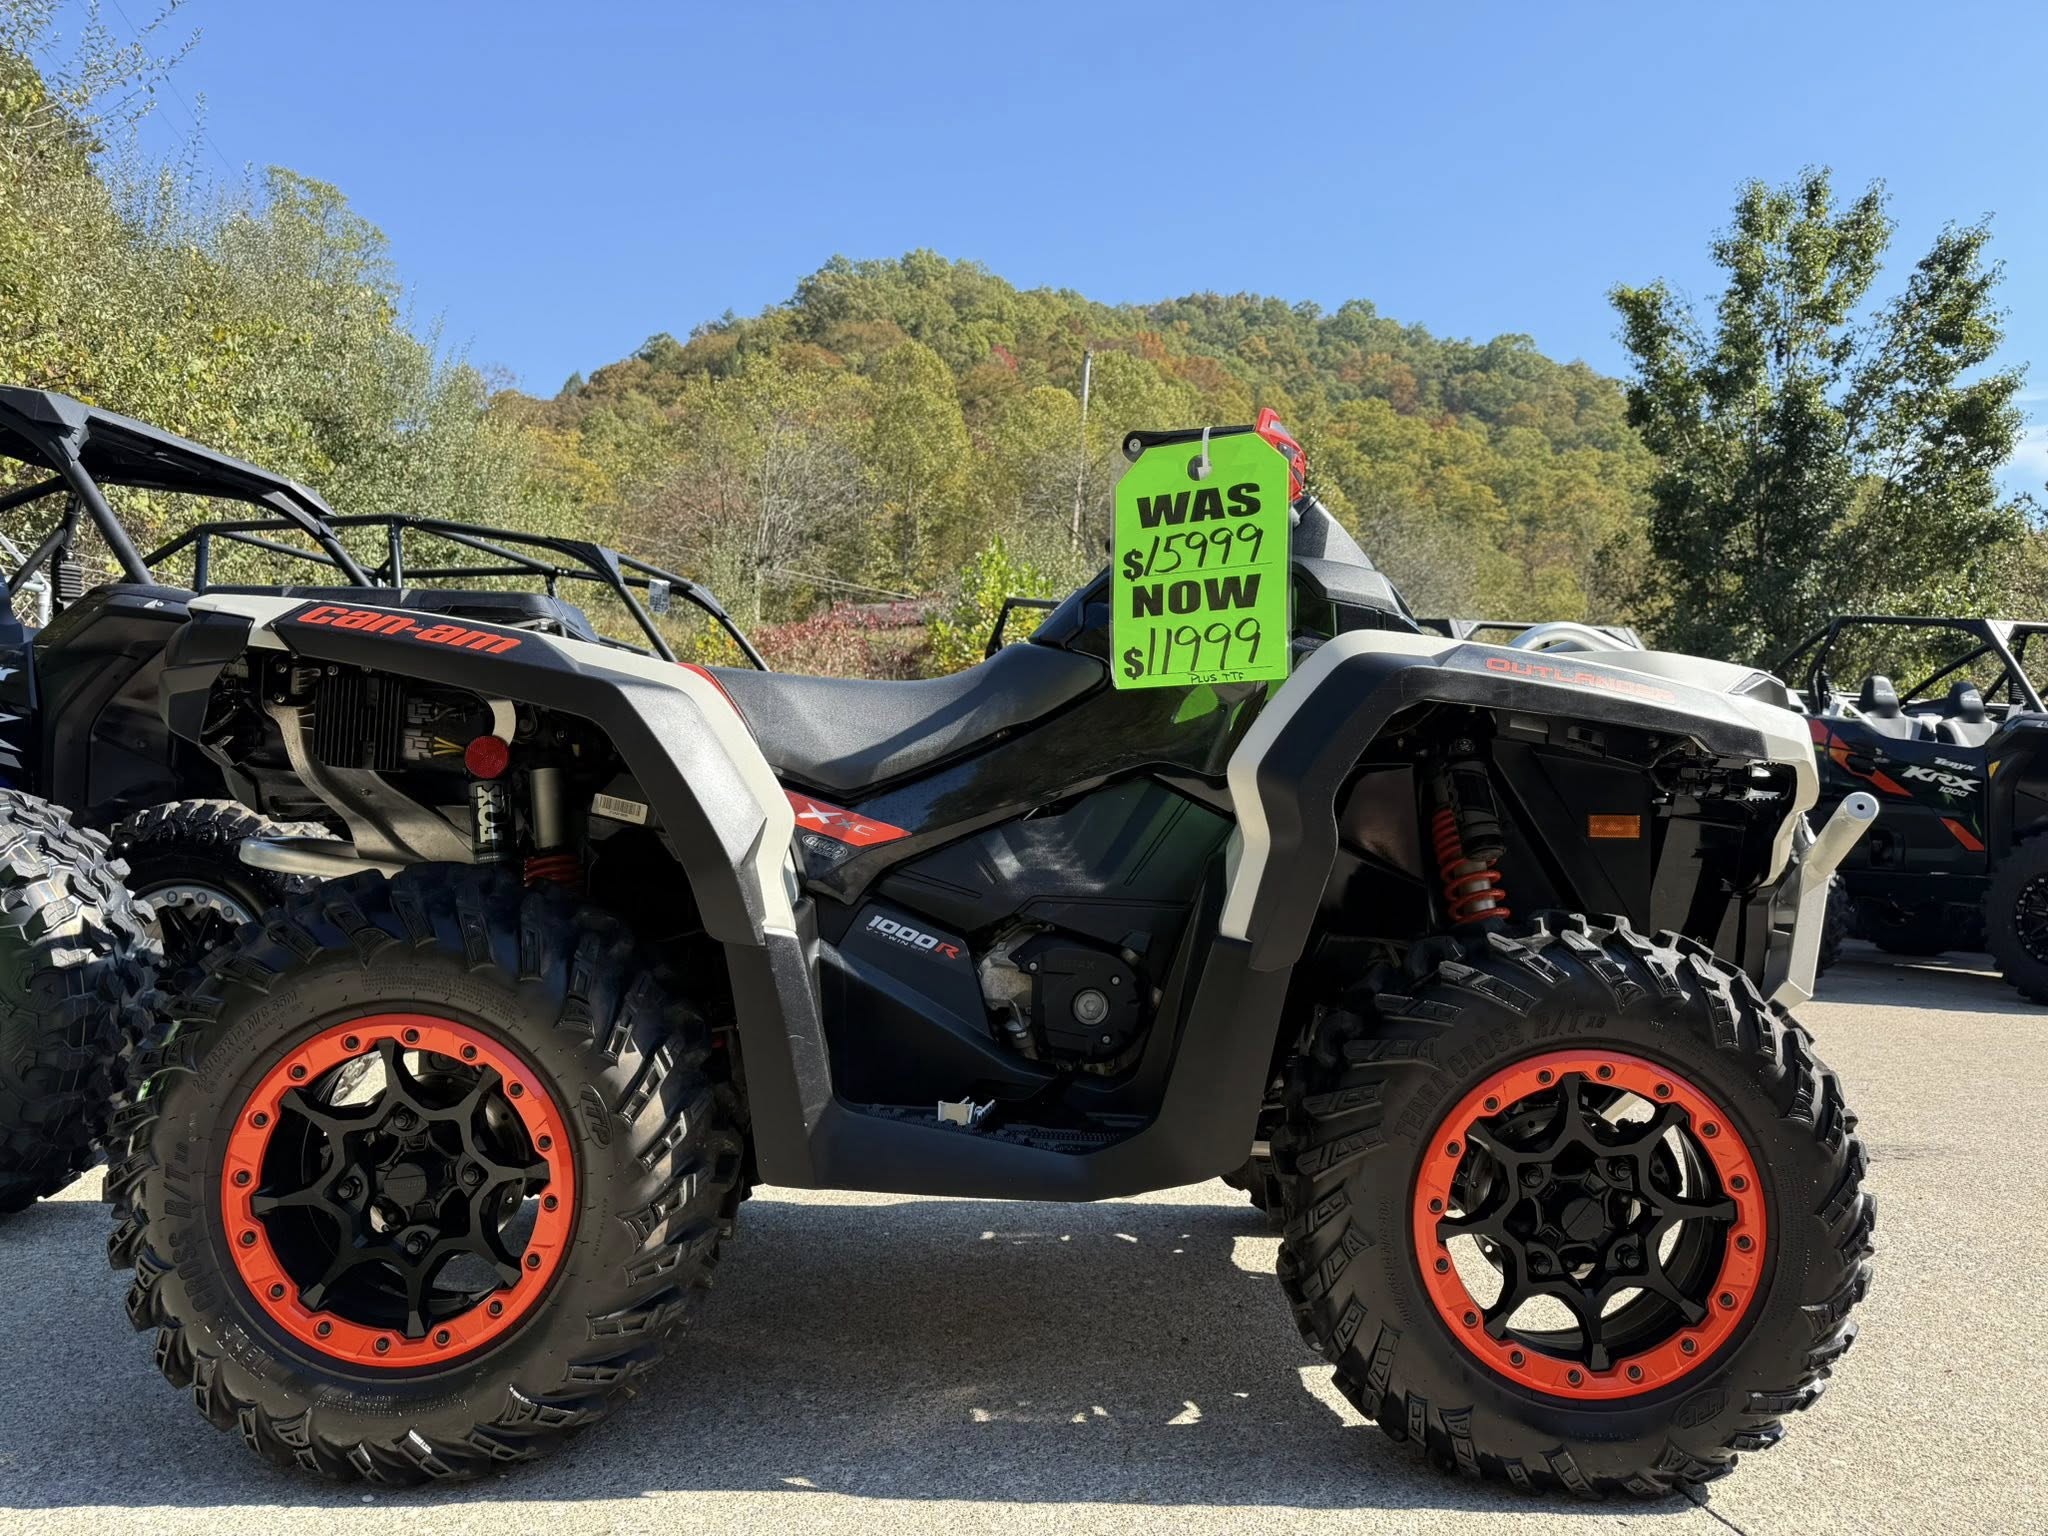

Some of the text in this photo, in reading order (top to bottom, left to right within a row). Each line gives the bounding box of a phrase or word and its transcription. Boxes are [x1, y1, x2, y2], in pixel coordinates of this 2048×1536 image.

[1136, 482, 1261, 528] WAS
[1122, 523, 1264, 582] $15999
[1132, 573, 1261, 618] NOW
[1123, 617, 1261, 680] $11999
[1188, 672, 1217, 683] PLUS
[1486, 658, 1676, 704] OUTLANDER
[1902, 765, 1982, 792] KRX
[1938, 786, 1969, 797] 1000
[476, 784, 503, 844] FOX
[868, 915, 960, 959] 1000R
